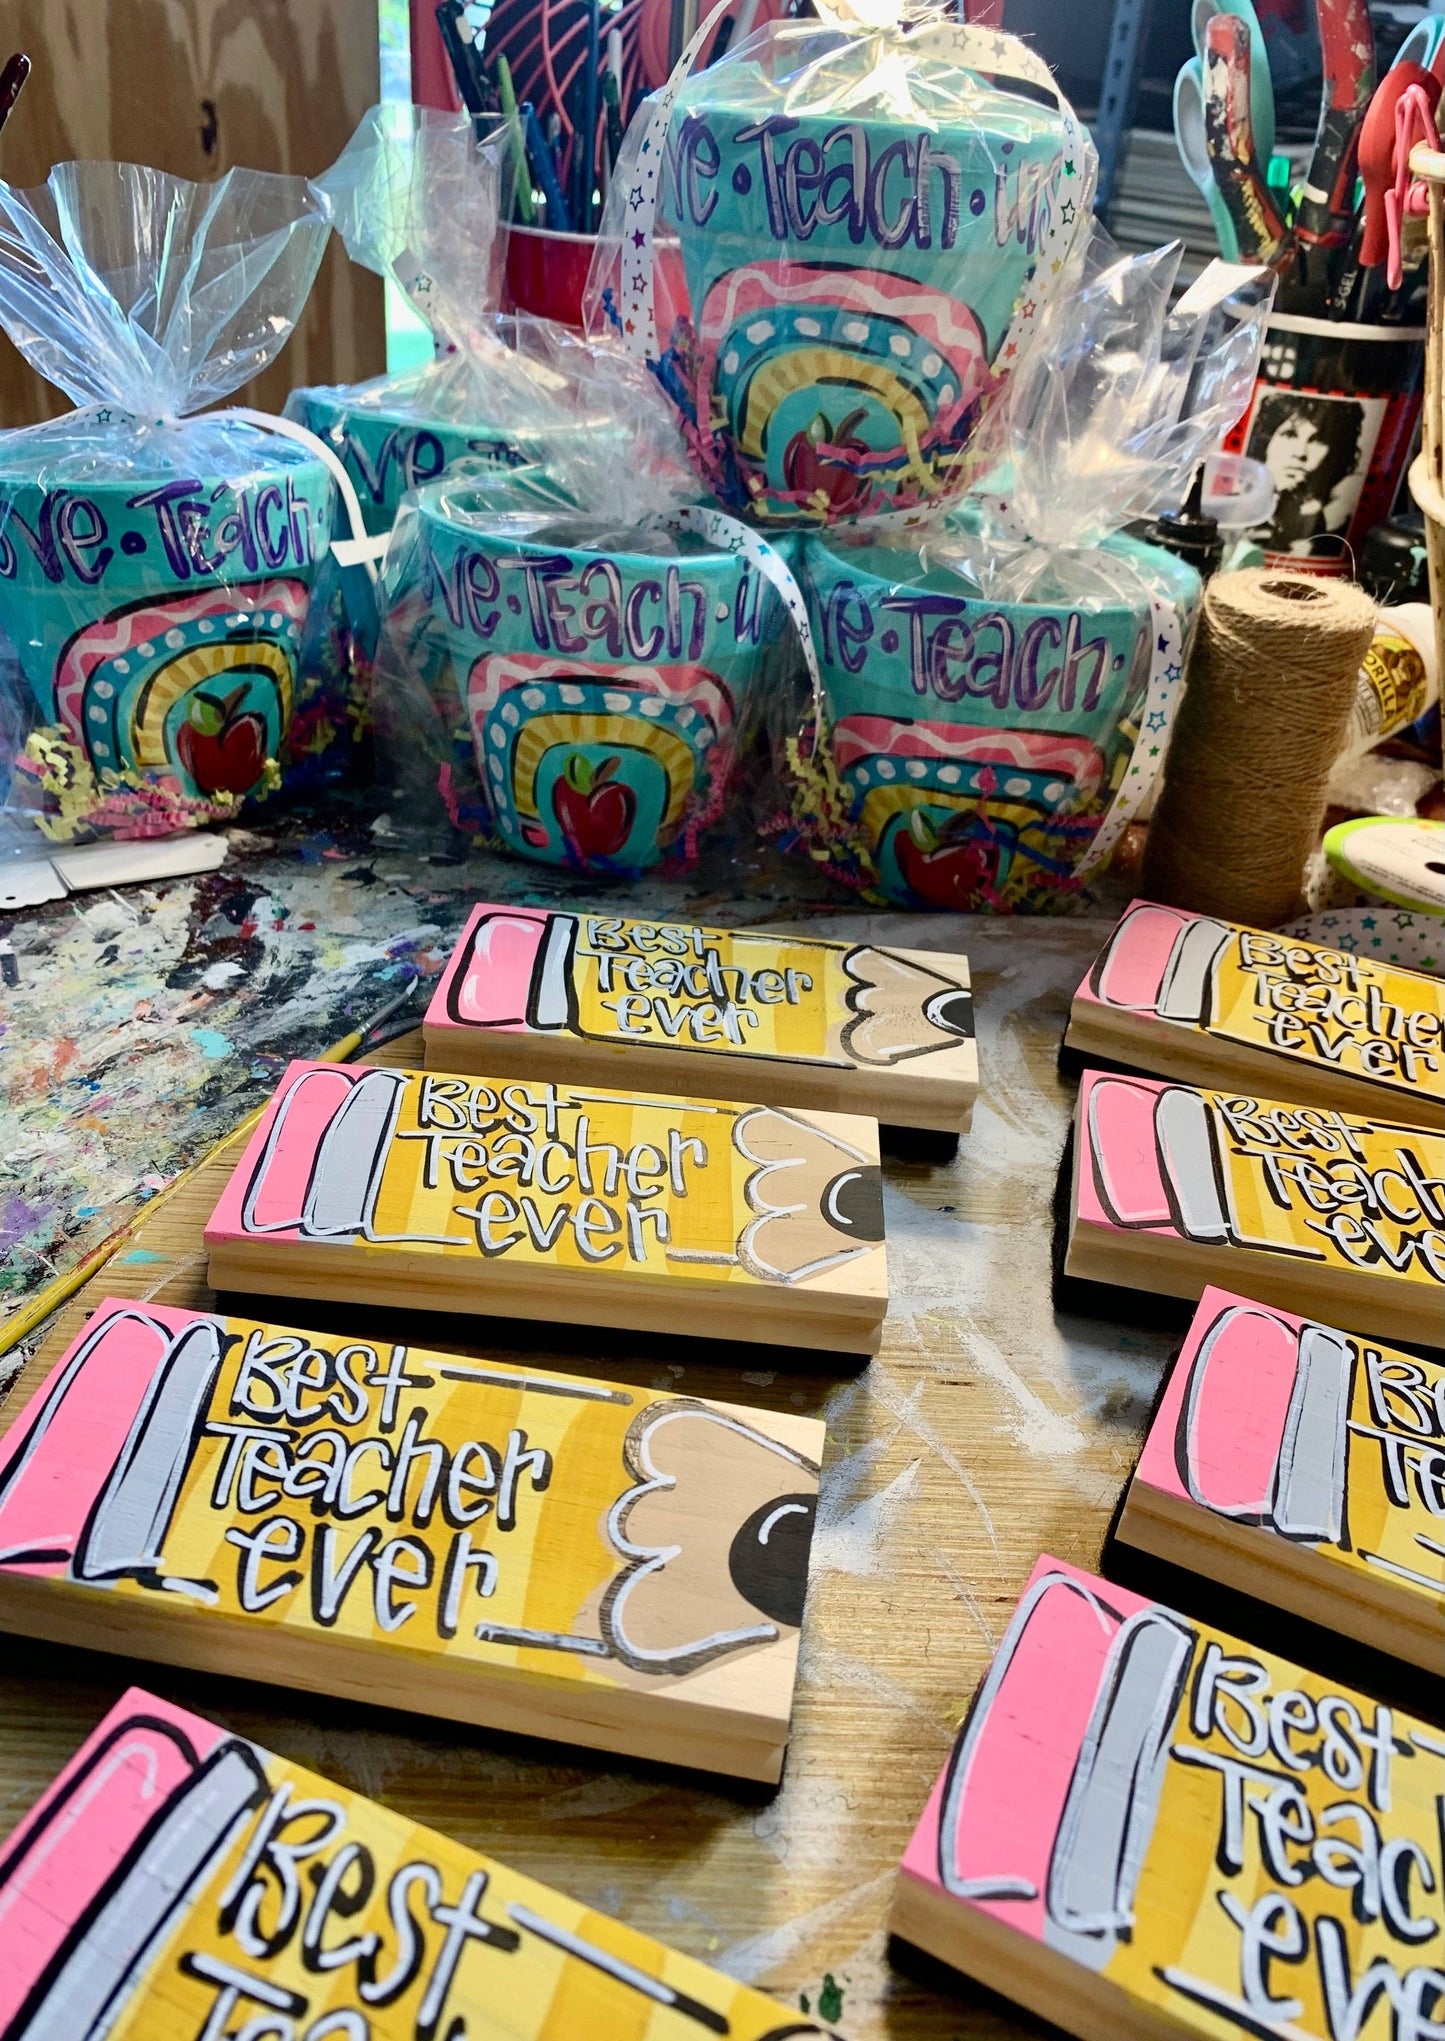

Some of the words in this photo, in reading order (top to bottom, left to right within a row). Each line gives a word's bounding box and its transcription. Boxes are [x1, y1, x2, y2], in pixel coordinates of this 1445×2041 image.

[664, 114, 721, 227] ve
[732, 114, 961, 250] Teach
[0, 488, 114, 584] ve
[424, 544, 502, 640] ve
[879, 595, 1112, 713] Teach
[1363, 653, 1396, 720] ORILLA
[576, 949, 813, 1005] Teacher
[586, 917, 722, 955] Best
[1239, 931, 1374, 992] Best
[601, 994, 759, 1045] ever
[1237, 964, 1445, 1051] Teache
[1251, 1012, 1439, 1082] ever
[417, 1075, 582, 1140] Best
[1212, 1094, 1374, 1163] Best
[396, 1115, 708, 1199] Teacher
[453, 1191, 671, 1263] ever
[229, 1329, 435, 1433] Best
[200, 1406, 553, 1532] Teacher
[225, 1515, 499, 1639] ever
[1190, 1641, 1415, 1812] Best
[1169, 1744, 1445, 1946] Teac
[217, 1781, 521, 2041] Best
